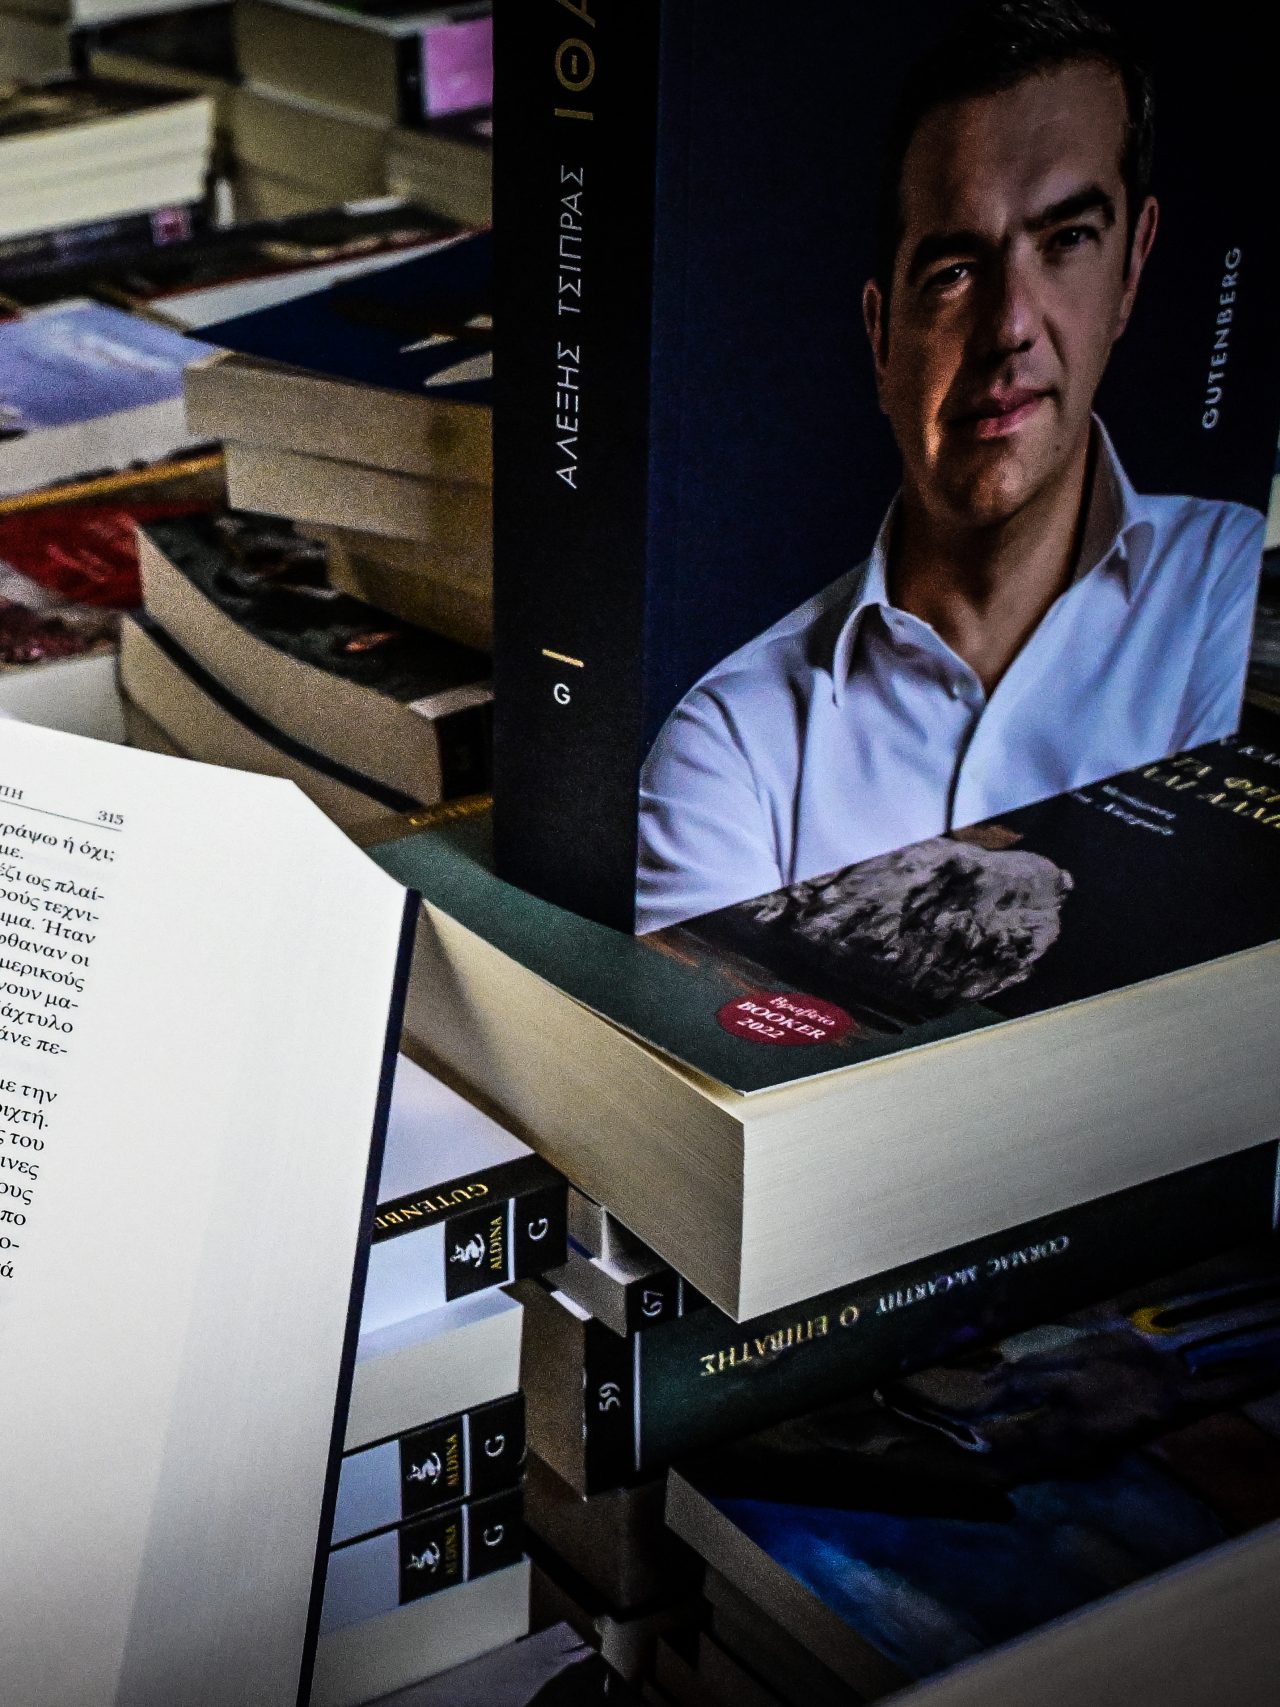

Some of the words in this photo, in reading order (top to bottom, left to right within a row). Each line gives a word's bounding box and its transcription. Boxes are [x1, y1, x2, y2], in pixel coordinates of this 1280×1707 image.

[557, 164, 584, 315] ΤΣΙΠΡΑΣ
[1201, 247, 1242, 429] GUTENBERG
[555, 341, 580, 489] ΑΛΕΞΗΣ
[553, 682, 571, 705] G
[96, 809, 124, 826] 315
[63, 836, 75, 855] ή
[79, 840, 115, 863] όχι;
[25, 874, 52, 893] ως
[54, 880, 105, 901] πλαί-
[736, 1001, 826, 1039] BOOKER
[736, 1017, 786, 1039] 2022
[21, 1084, 58, 1105] την
[489, 1215, 503, 1270] ALDINA
[528, 1217, 549, 1241] G
[641, 1290, 664, 1317] 67
[839, 1305, 861, 1328] Ο
[699, 1314, 830, 1377] ΕΠΙΒΑΤΗΣ
[598, 1382, 621, 1412] 59
[484, 1434, 505, 1458] G
[483, 1524, 504, 1546] G
